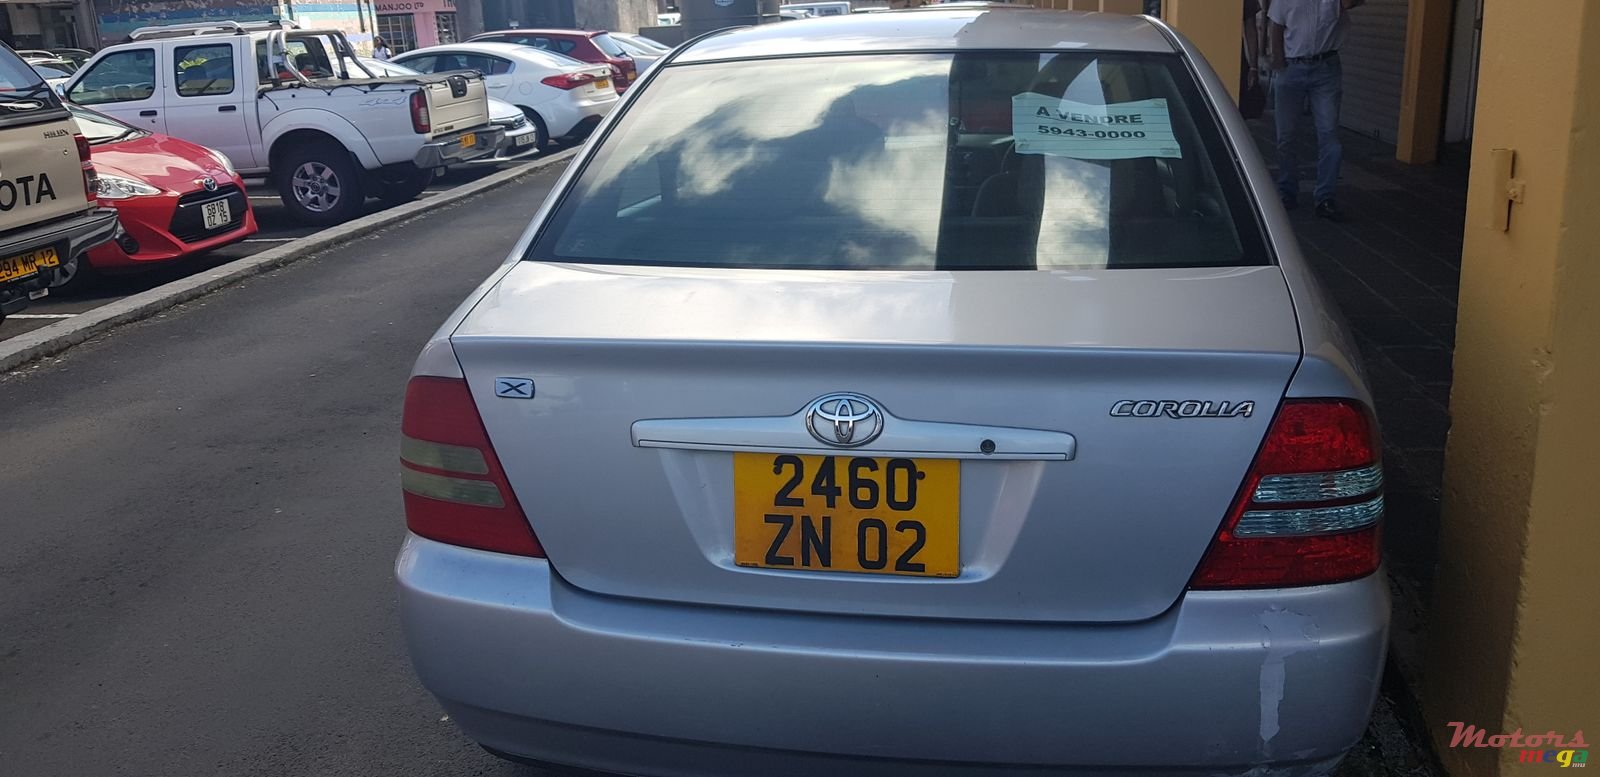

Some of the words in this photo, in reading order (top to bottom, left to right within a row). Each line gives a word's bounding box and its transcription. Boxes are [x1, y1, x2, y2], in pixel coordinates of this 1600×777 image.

[375, 3, 412, 12] MANJOO
[1035, 106, 1050, 117] A
[1056, 109, 1144, 124] VENDRE
[1038, 125, 1146, 139] 5943-0000
[206, 200, 224, 216] 6818
[220, 210, 229, 225] 15
[21, 253, 38, 272] MR
[41, 248, 56, 265] 12
[1109, 400, 1255, 419] COROLLA
[773, 454, 918, 512] 2460
[764, 513, 832, 568] ZN
[857, 518, 926, 573] 02
